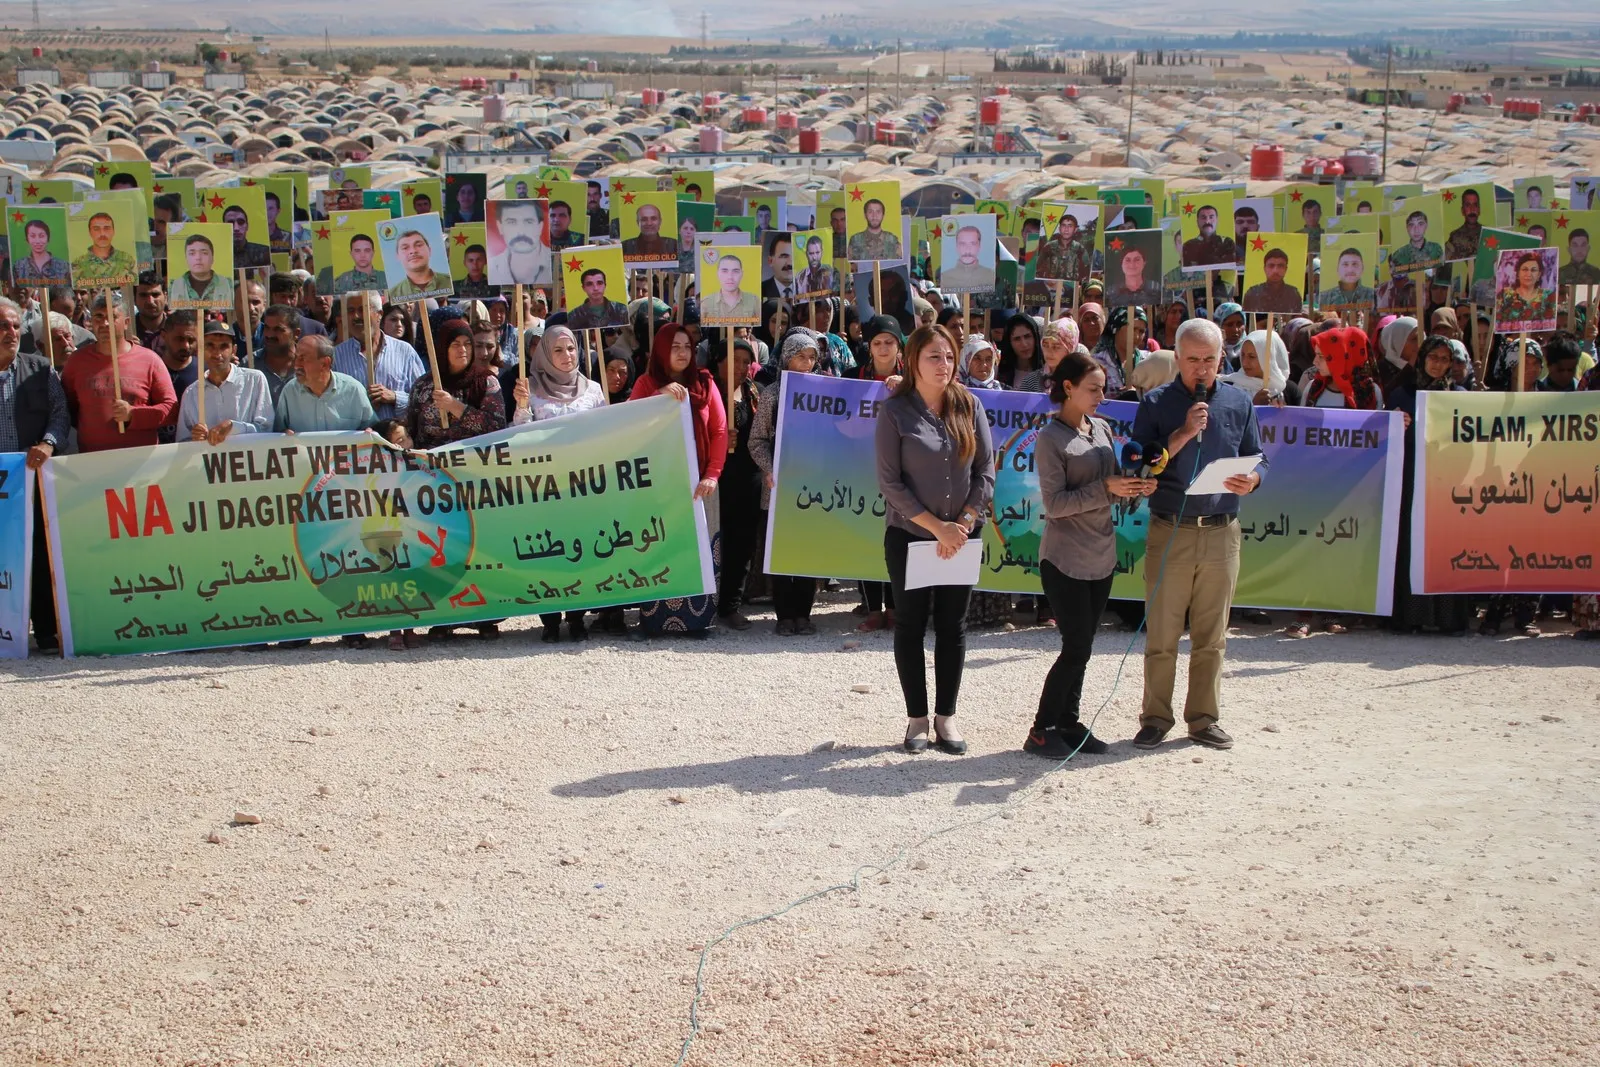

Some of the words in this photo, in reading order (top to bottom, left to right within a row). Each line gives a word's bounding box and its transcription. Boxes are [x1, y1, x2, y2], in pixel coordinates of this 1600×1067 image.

[792, 392, 851, 420] KURD,
[1541, 413, 1600, 441] XIRS
[1283, 426, 1298, 444] U
[1305, 427, 1379, 448] ERMEN
[202, 447, 298, 484] WELAT
[427, 449, 466, 470] ME
[474, 441, 512, 466] YE
[104, 484, 174, 539] NA
[182, 501, 208, 533] JI
[217, 488, 410, 531] DAGIRKERIYA
[417, 474, 561, 516] OSMANIYA
[568, 463, 607, 499] NU
[615, 456, 653, 492] RE
[796, 479, 866, 516] والأرمن
[1451, 471, 1535, 515] الشعوب
[416, 525, 447, 568] لا
[512, 528, 583, 563] وطننا
[593, 515, 666, 557] الوطن
[1315, 515, 1359, 546] الكرد
[109, 563, 185, 604] الجديد
[197, 554, 298, 601] العثماني
[310, 542, 411, 586] للاحتلال
